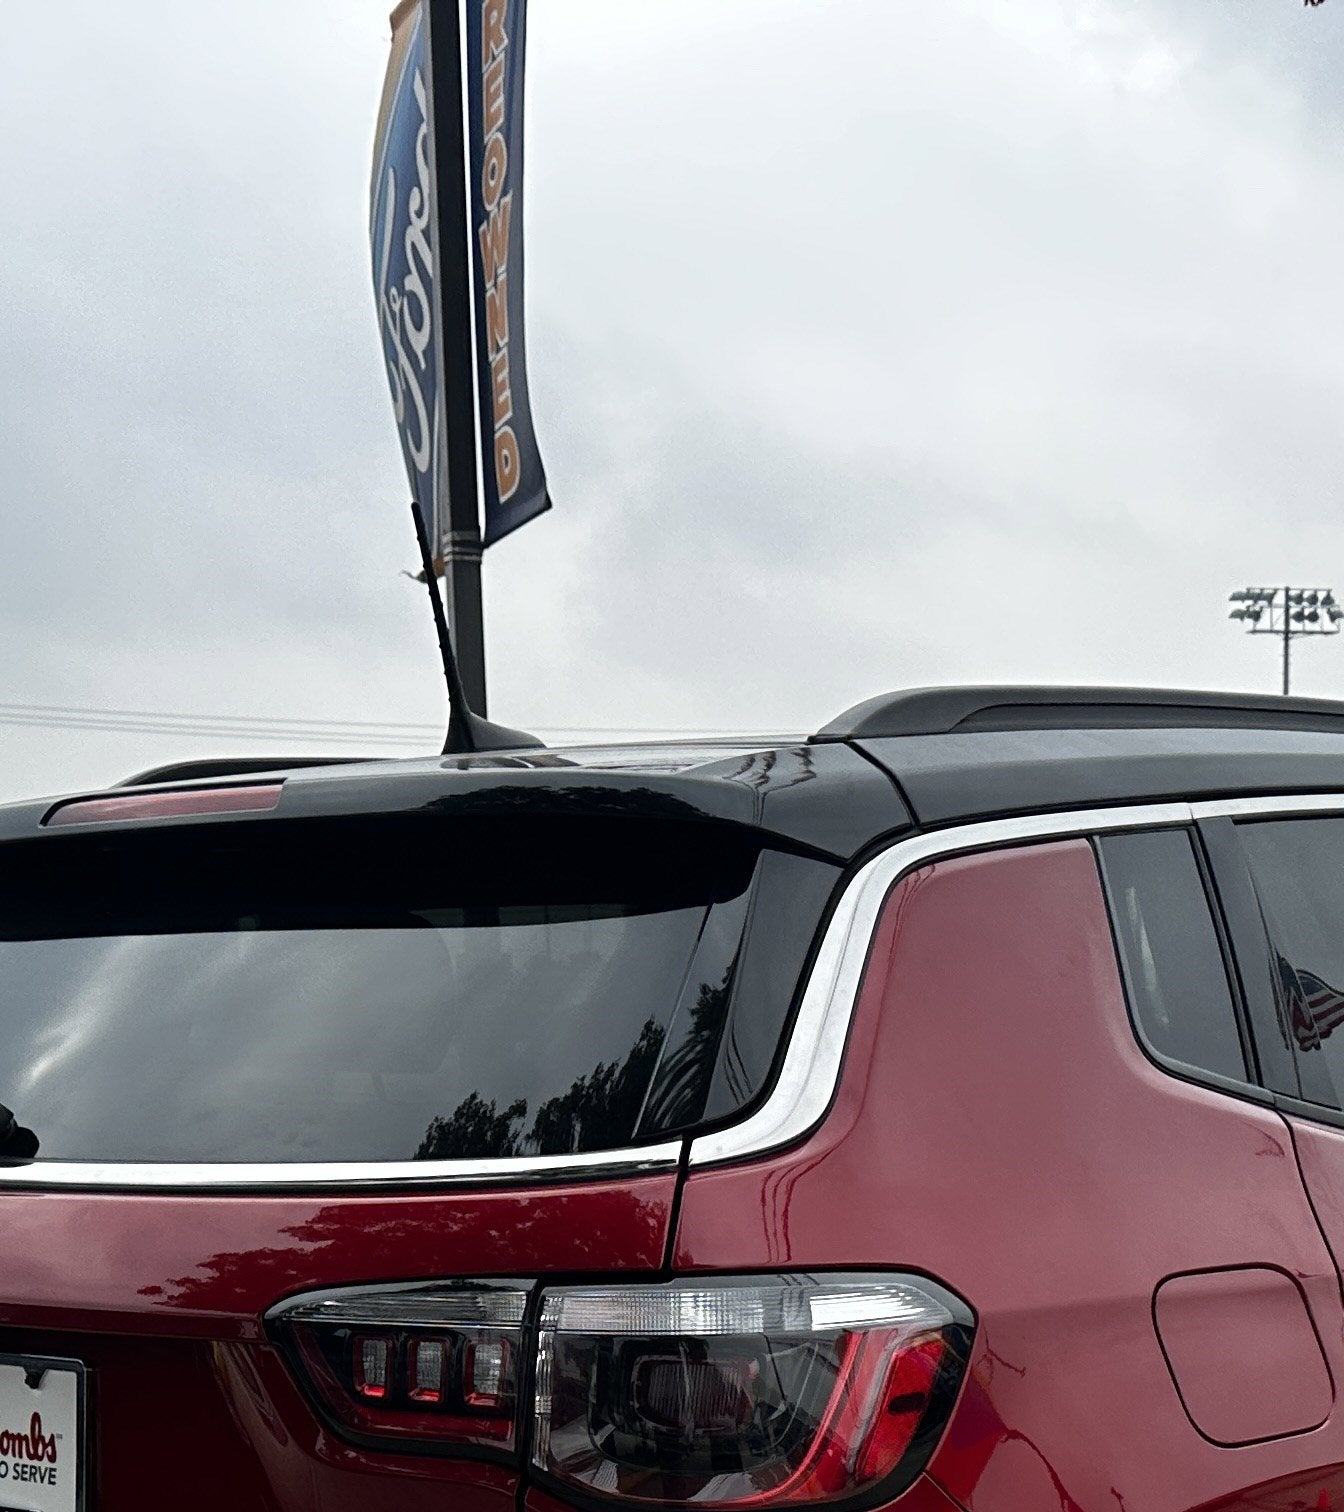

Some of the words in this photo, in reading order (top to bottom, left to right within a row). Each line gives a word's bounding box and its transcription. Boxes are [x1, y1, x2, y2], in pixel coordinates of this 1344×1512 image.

[380, 67, 435, 473] Ford
[479, 0, 521, 504] REOWNED
[13, 1463, 57, 1486] SERVE
